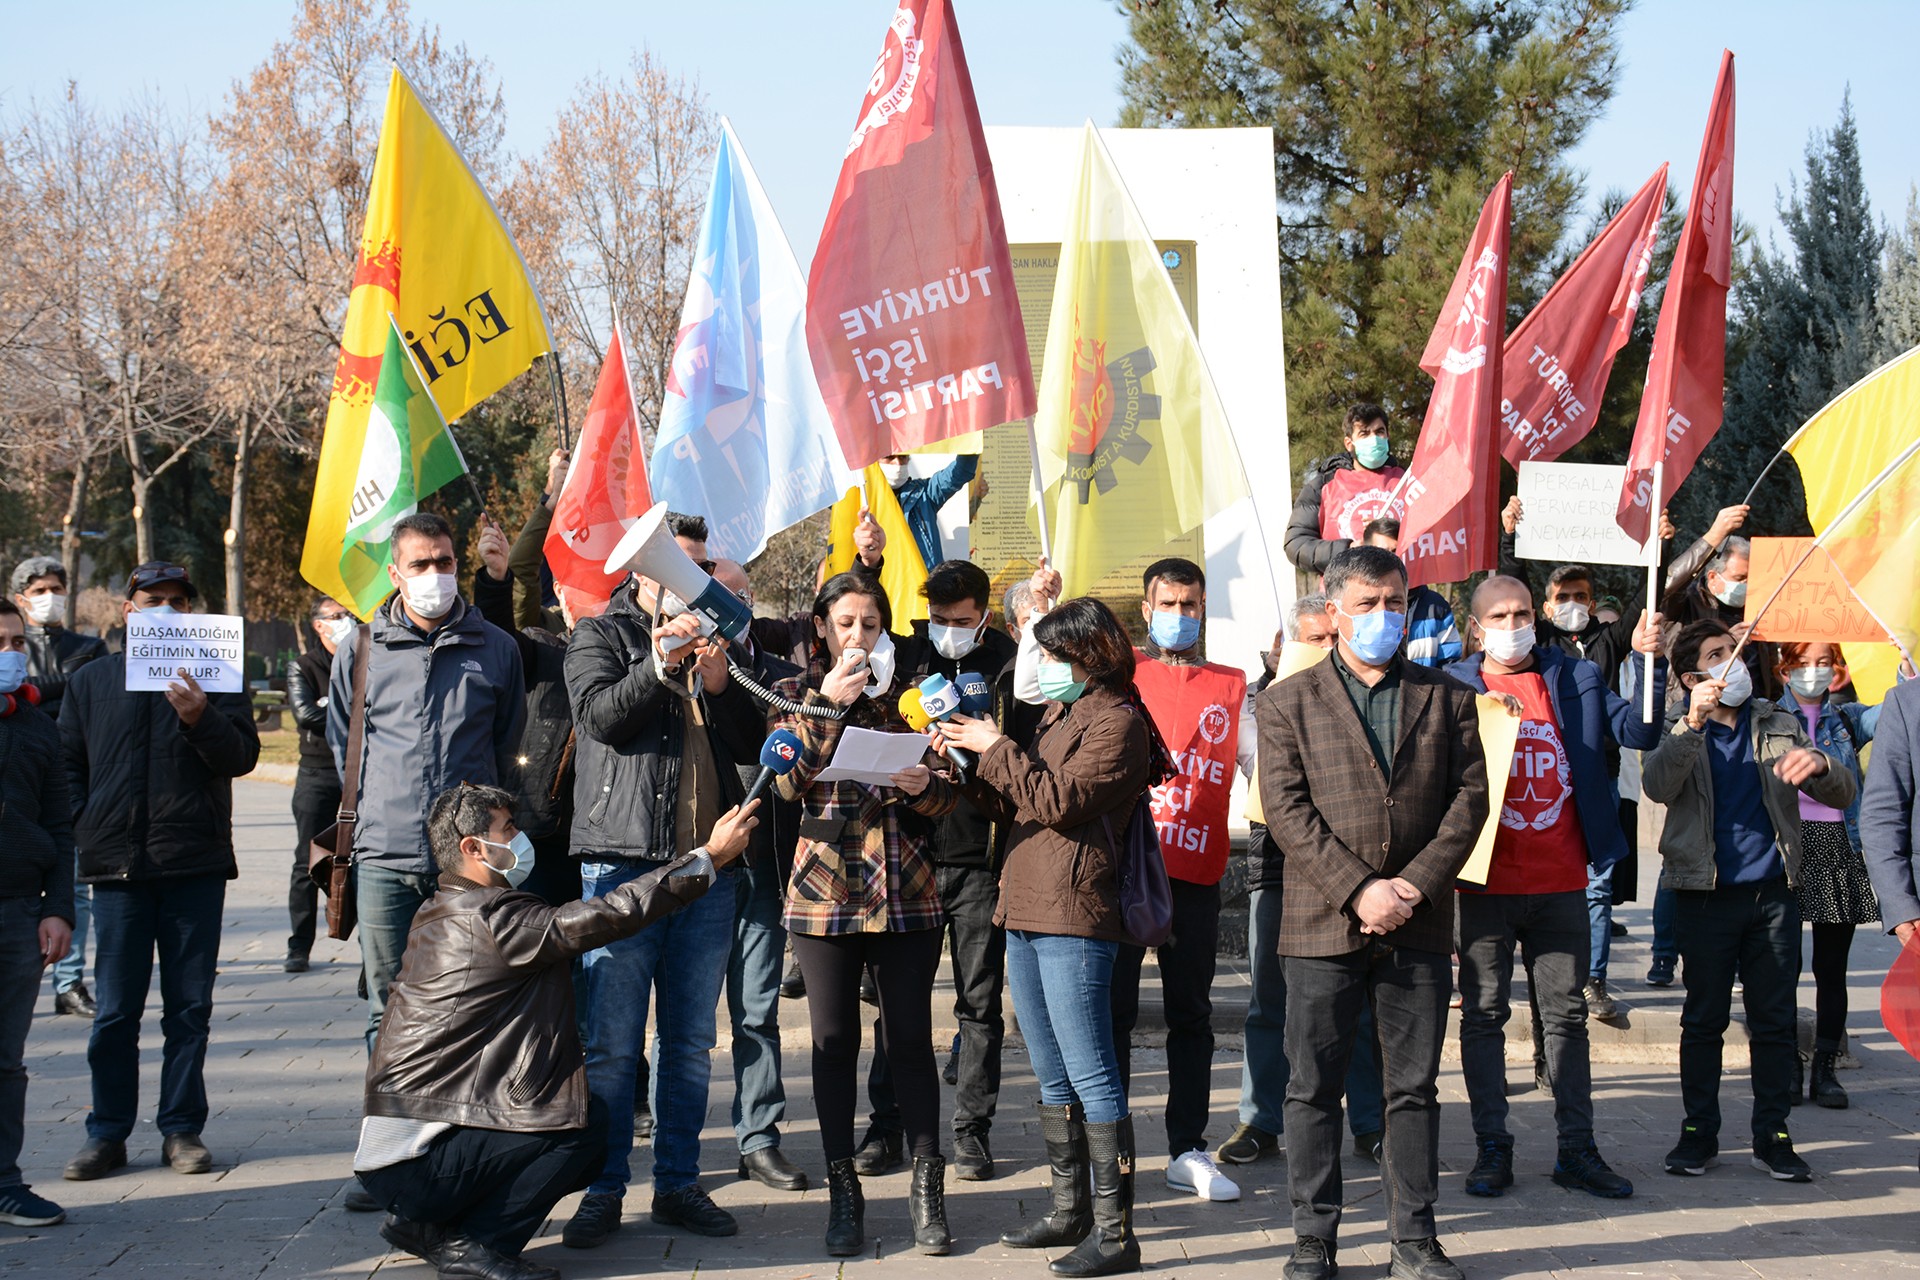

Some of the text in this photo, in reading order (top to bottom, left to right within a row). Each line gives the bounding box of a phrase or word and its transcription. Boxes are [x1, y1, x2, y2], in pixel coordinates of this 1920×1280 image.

[1012, 258, 1059, 269] SAN HAKLA
[1533, 472, 1615, 492] PERGALA
[560, 487, 590, 544] HDP
[130, 626, 240, 640] ULAŞAMADIĞIM
[131, 643, 238, 659] EĞİTİMİN NOTU
[148, 666, 172, 677] MU
[925, 699, 944, 713] DW
[1209, 713, 1224, 727] TİP
[771, 739, 796, 761] K24
[1170, 747, 1225, 785] KİYE
[1149, 783, 1193, 817] ŞÇİ
